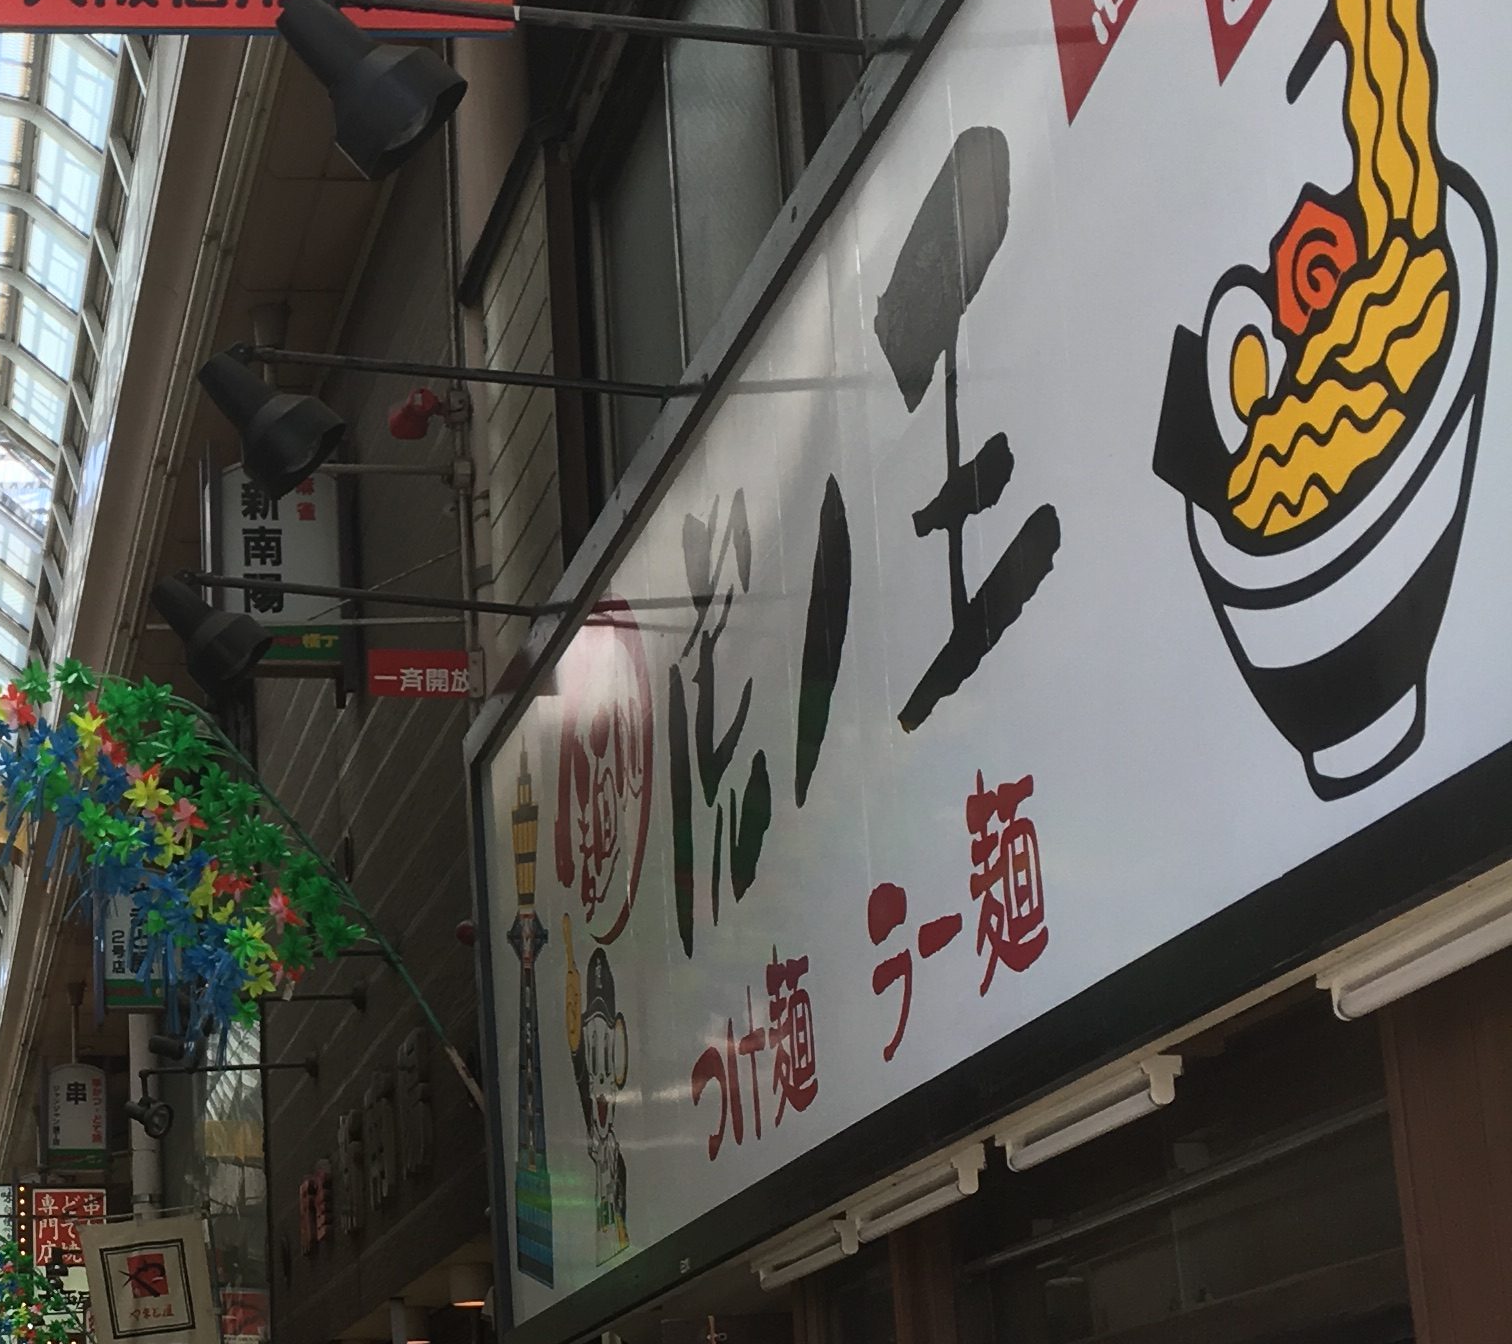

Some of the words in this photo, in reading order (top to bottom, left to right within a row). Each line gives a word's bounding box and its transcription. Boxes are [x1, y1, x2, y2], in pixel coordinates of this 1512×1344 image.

[242, 482, 284, 613] 新南陽
[668, 126, 1063, 961] 虎ノ王
[373, 666, 470, 693] 一斉開放
[867, 768, 1051, 1065] ラー麺
[691, 944, 819, 1162] つけ麺
